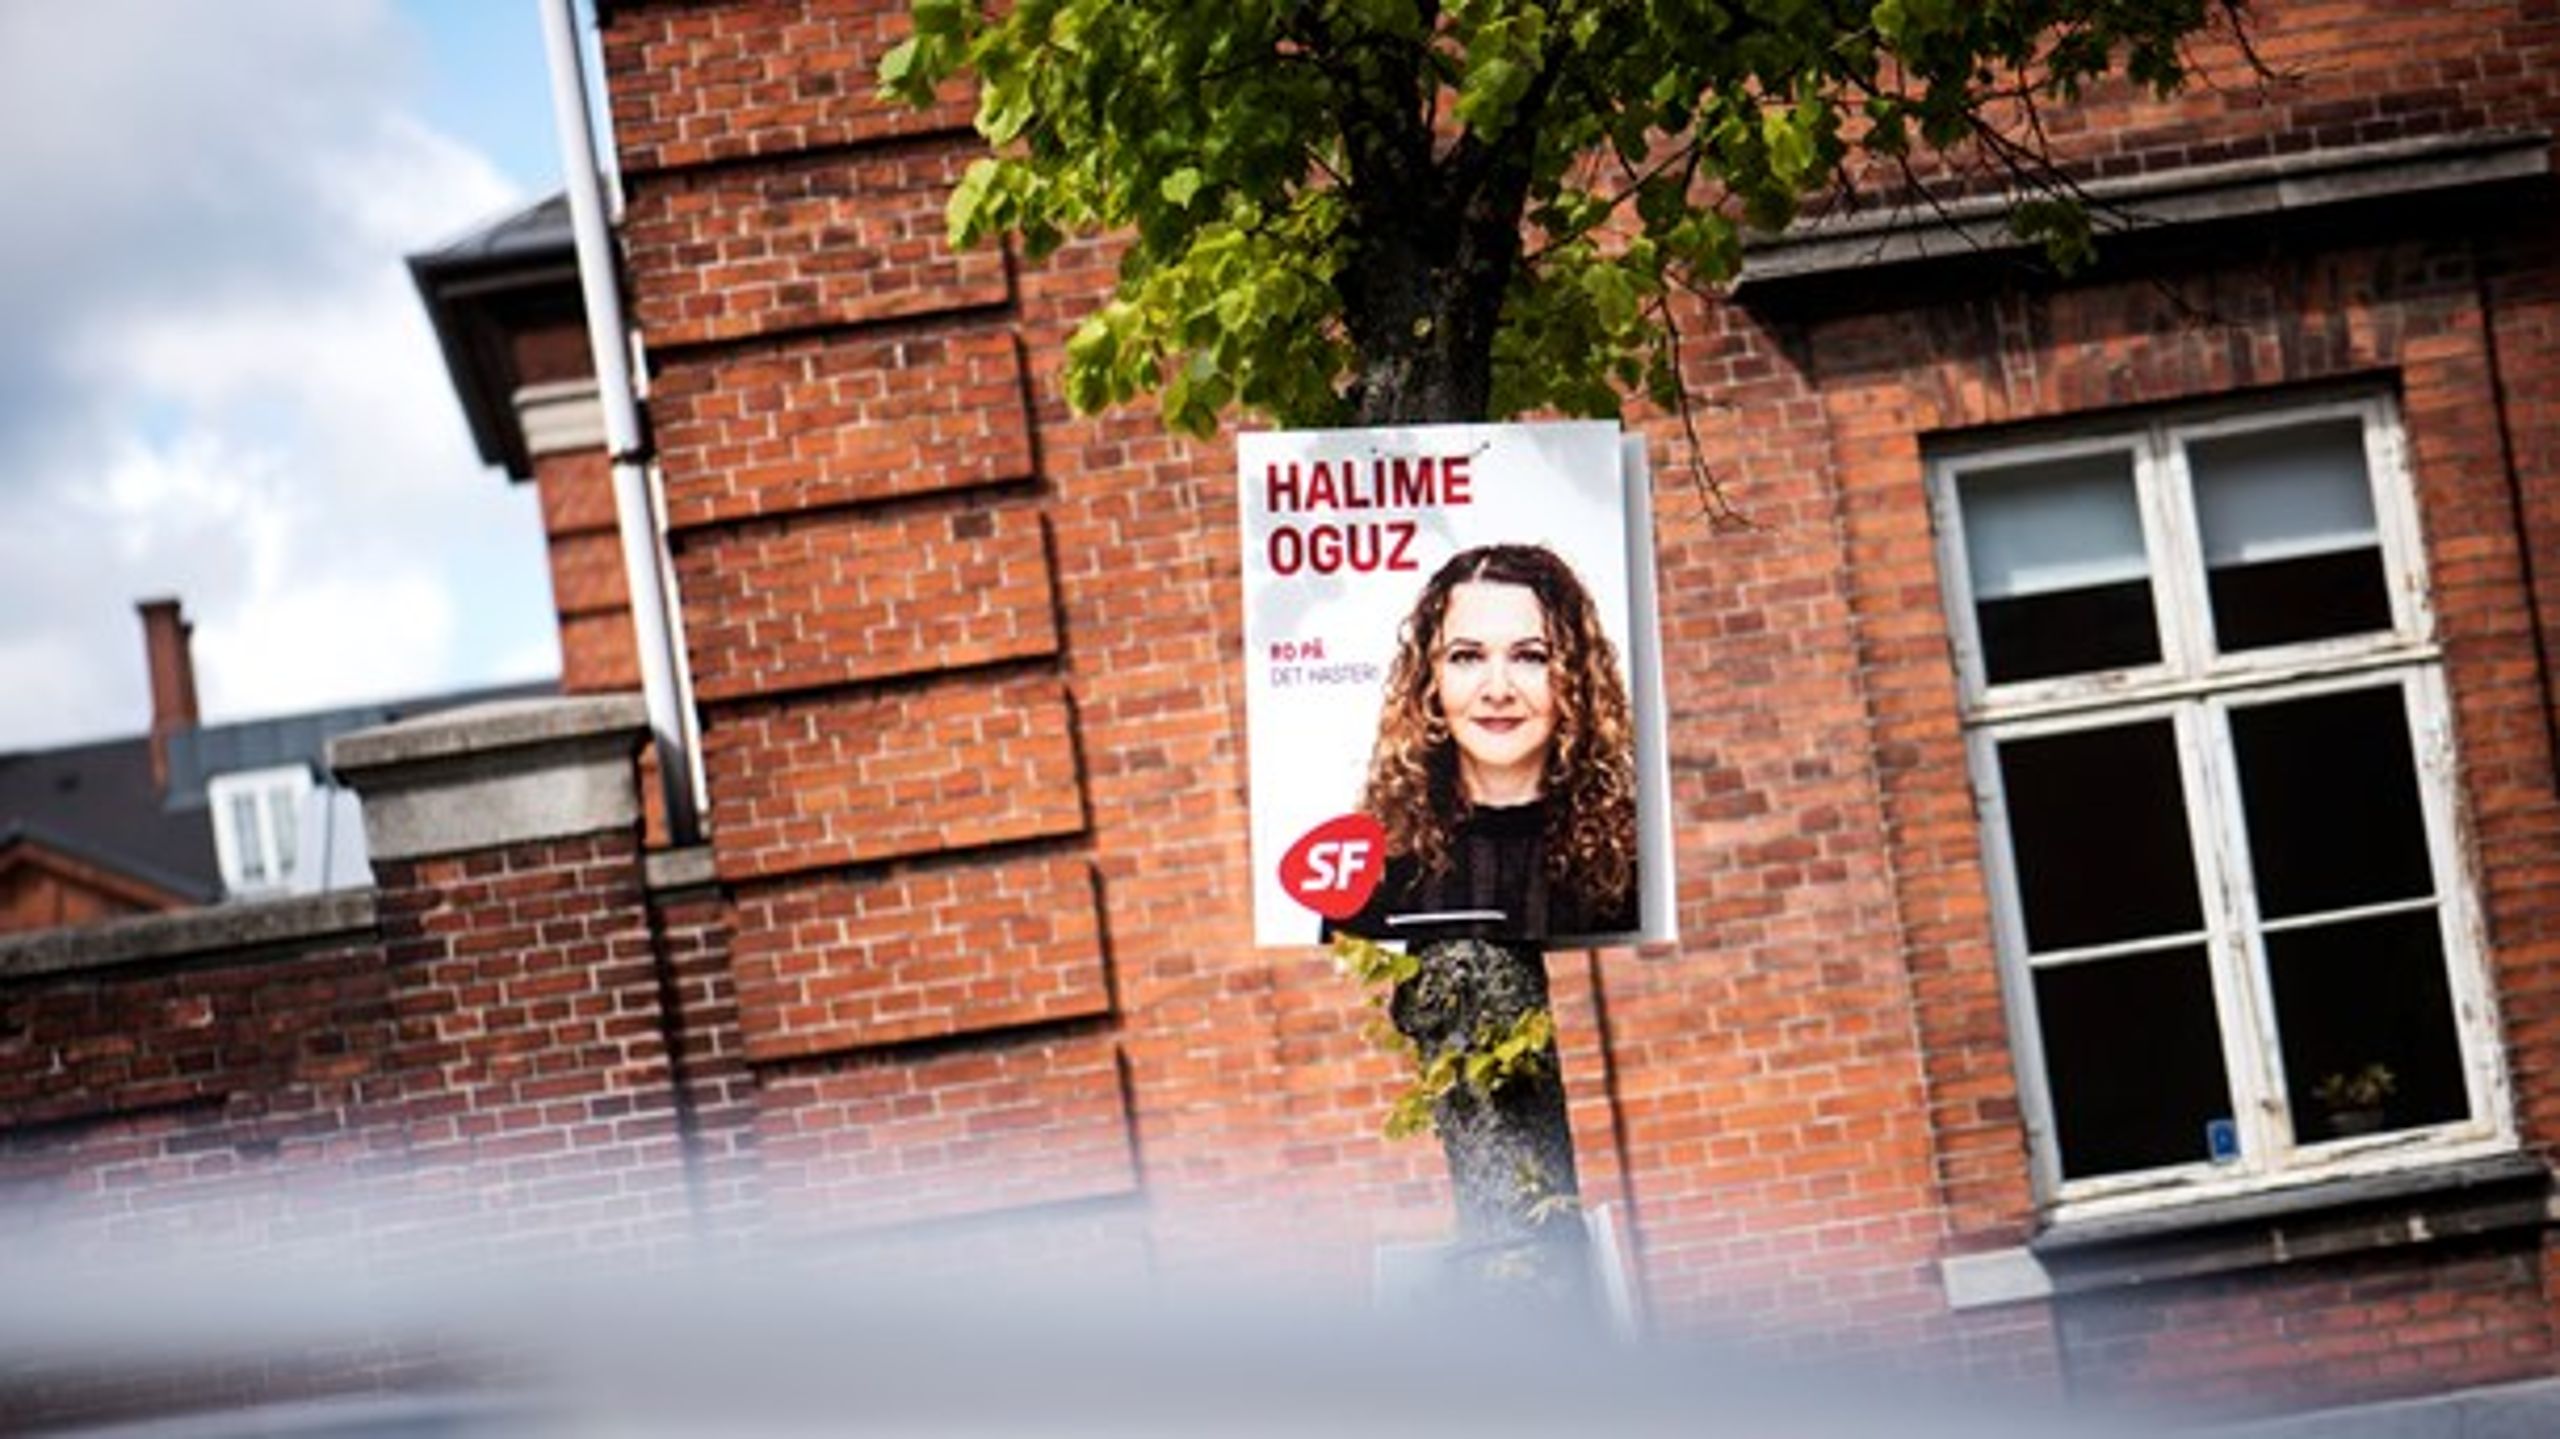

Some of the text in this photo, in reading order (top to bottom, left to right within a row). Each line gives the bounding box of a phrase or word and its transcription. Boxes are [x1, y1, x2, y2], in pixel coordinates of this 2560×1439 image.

[1267, 457, 1471, 512] HALIME
[1270, 521, 1418, 575] OGUZ
[1301, 840, 1370, 890] SF
